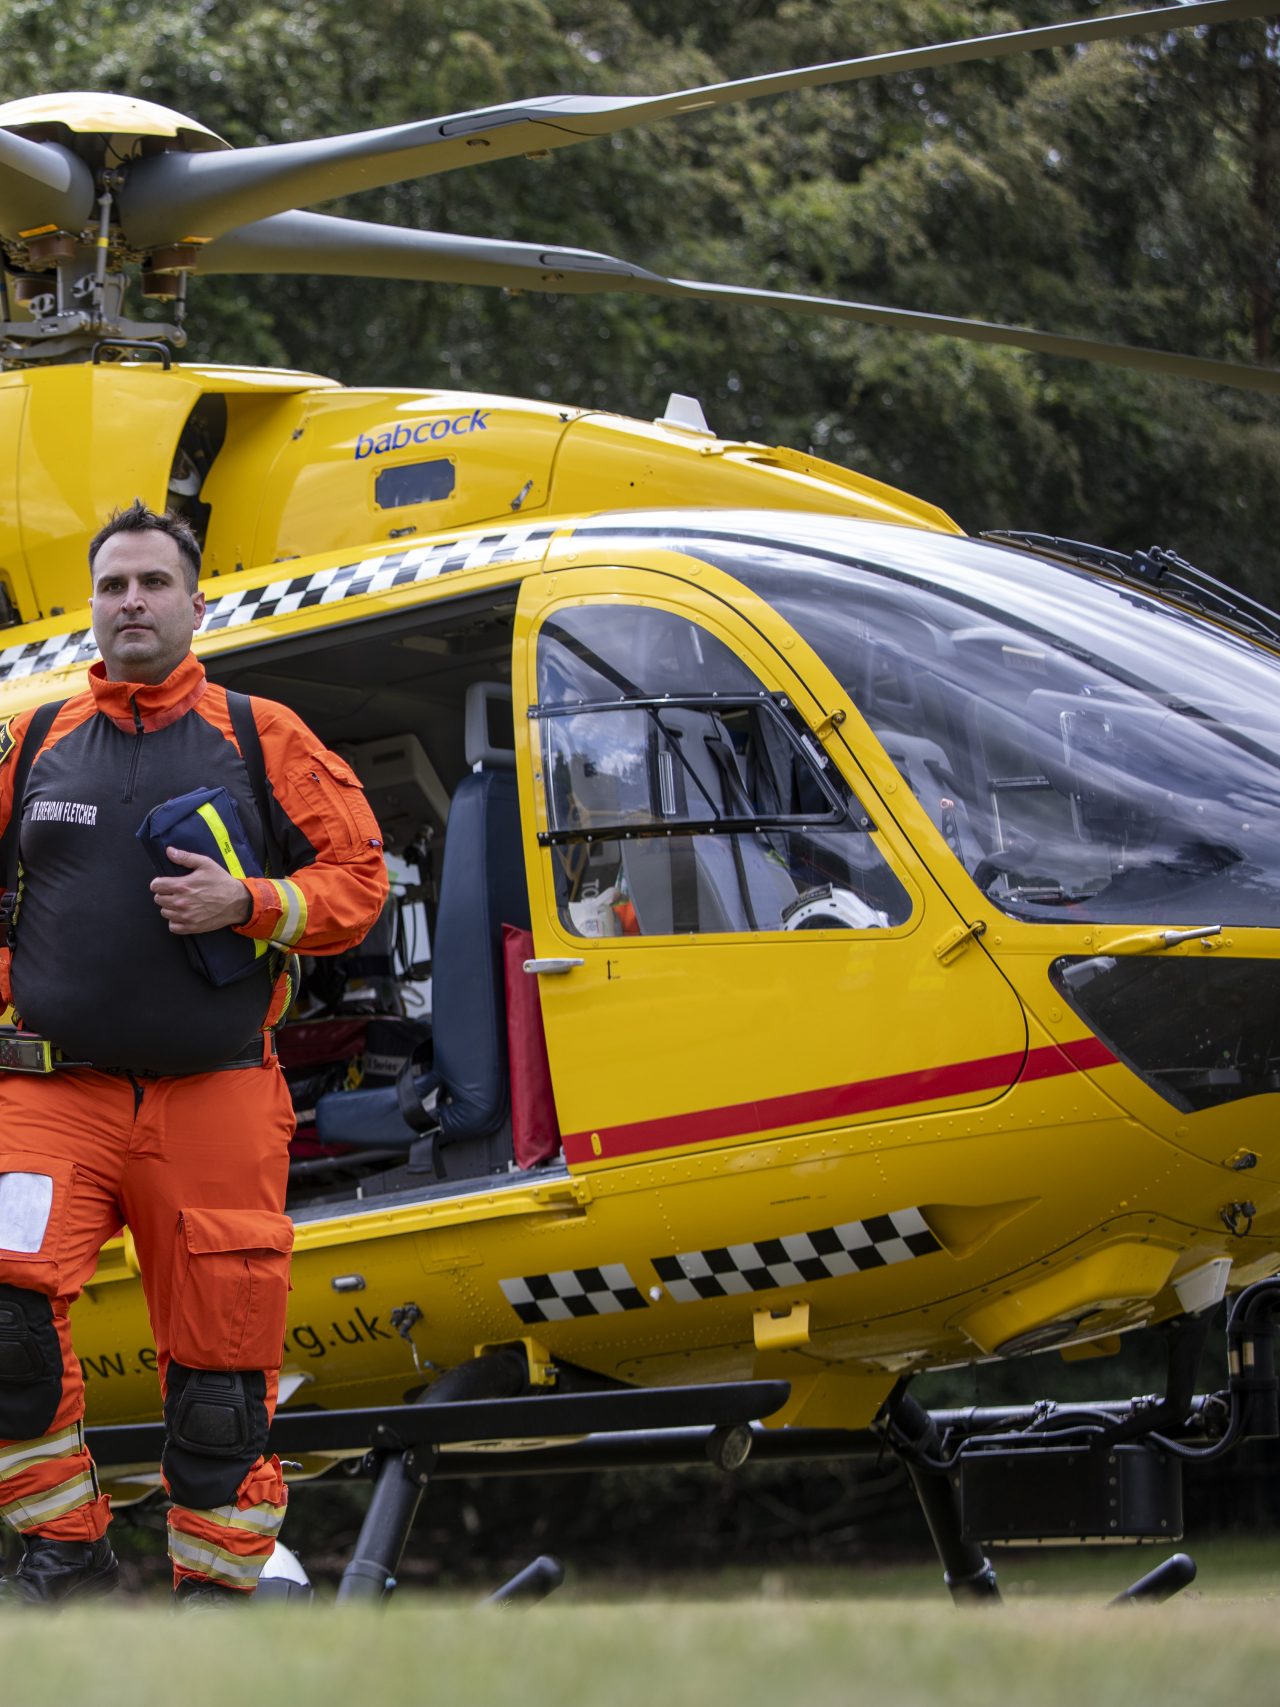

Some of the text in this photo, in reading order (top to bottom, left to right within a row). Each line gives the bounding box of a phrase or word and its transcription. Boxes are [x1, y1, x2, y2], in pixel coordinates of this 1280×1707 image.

[354, 409, 491, 460] babcock
[37, 801, 64, 821] BRENDAN
[63, 802, 98, 825] FLETCHER
